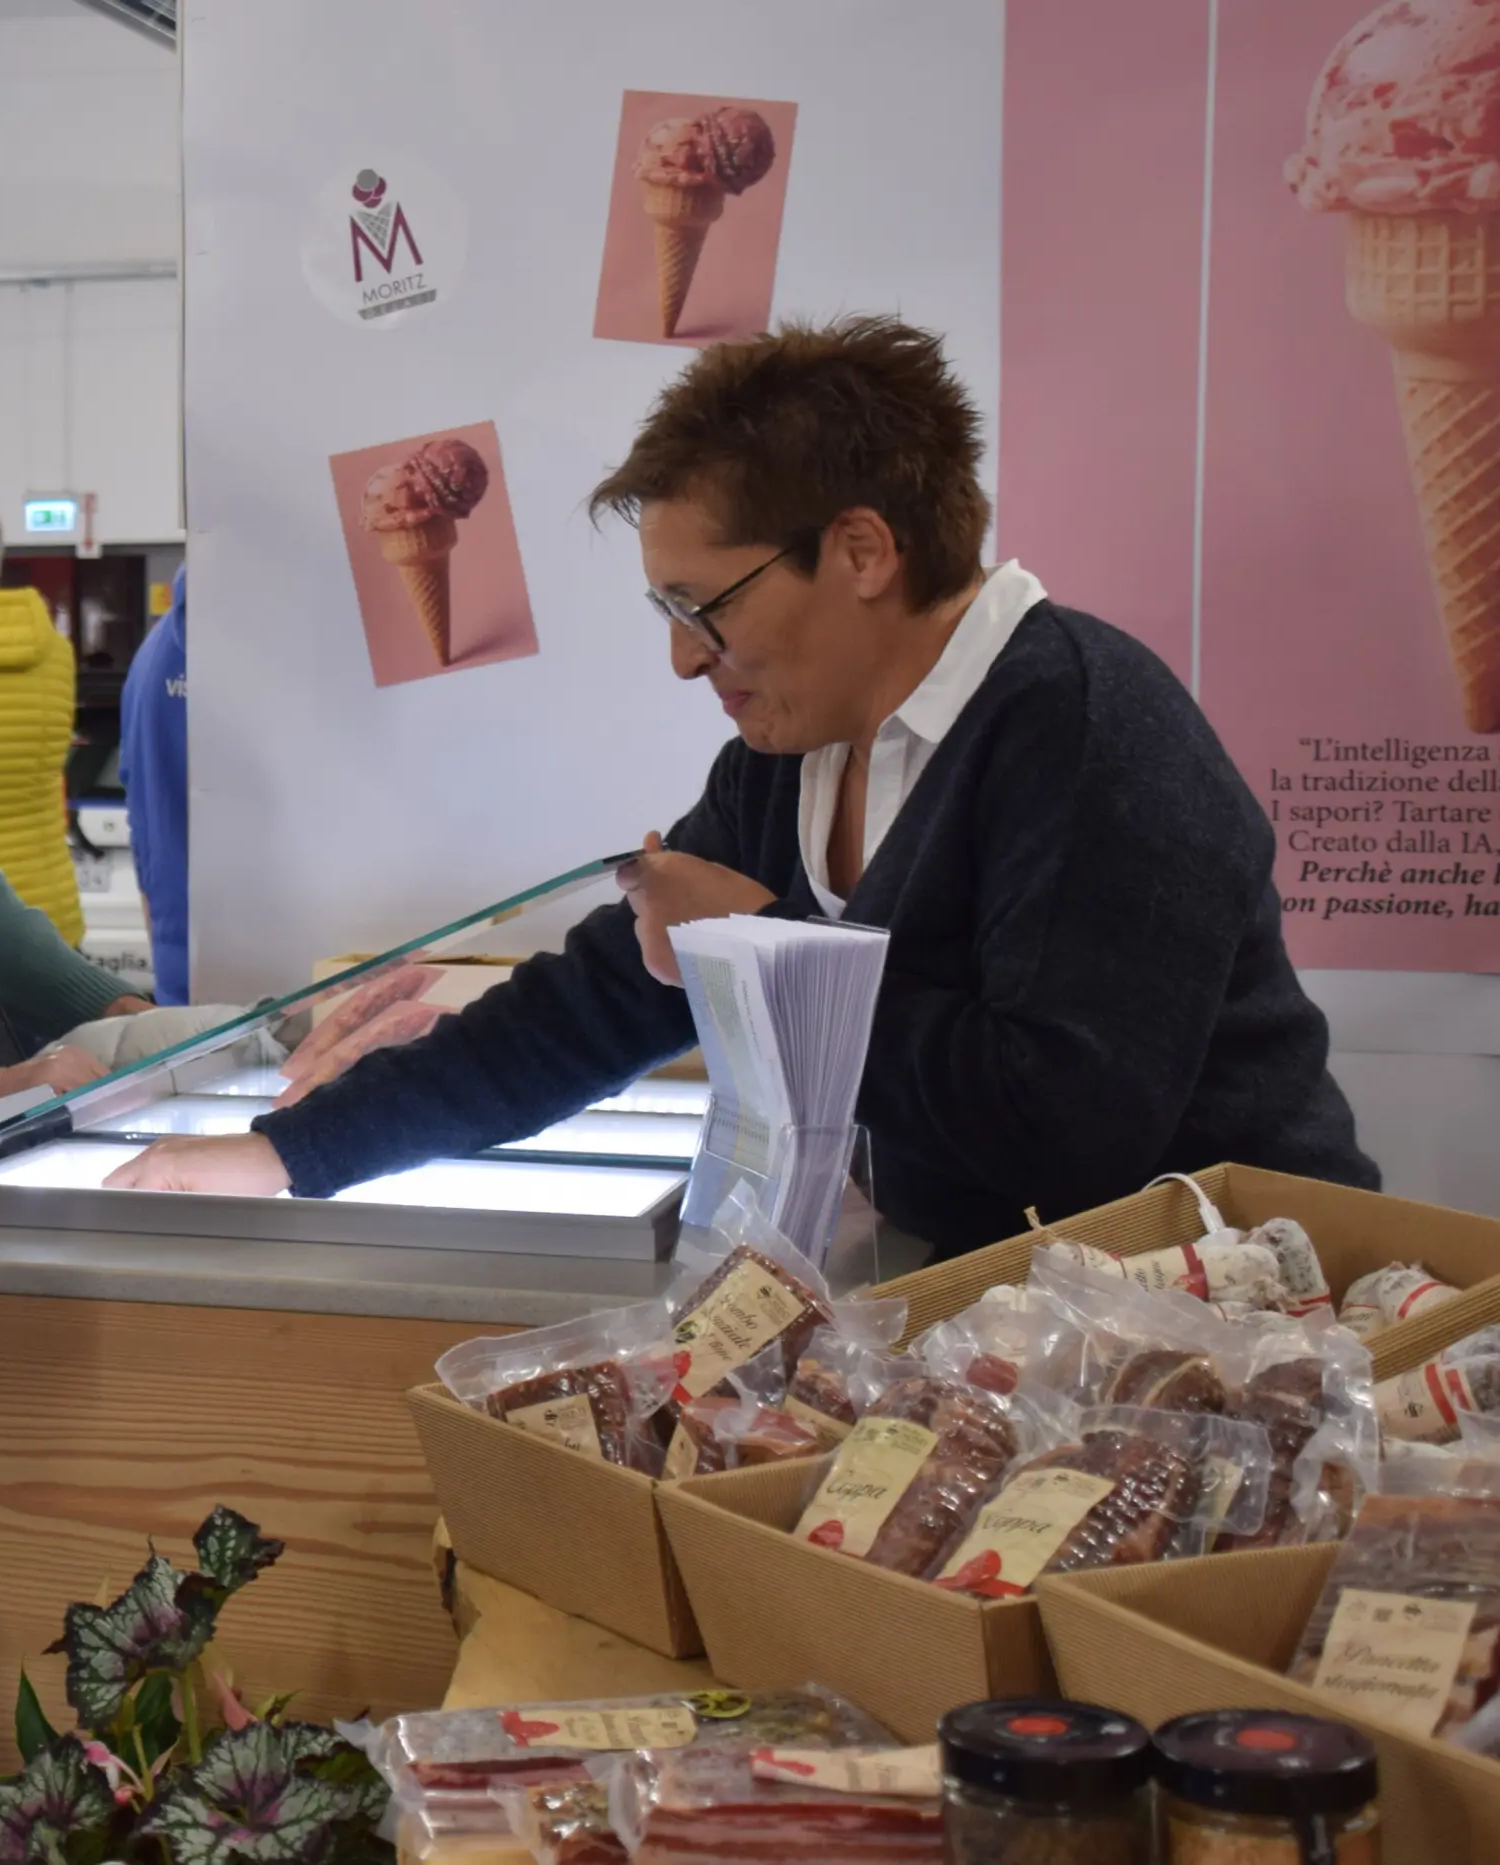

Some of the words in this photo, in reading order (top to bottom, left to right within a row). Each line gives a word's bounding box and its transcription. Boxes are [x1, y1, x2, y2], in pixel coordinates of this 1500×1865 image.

[362, 273, 428, 305] MORITZ
[1299, 738, 1490, 769] “L’intelligenza
[1271, 769, 1292, 792] la
[1302, 769, 1439, 793] tradizione
[1447, 769, 1500, 793] dell
[1272, 800, 1280, 822] I
[1290, 800, 1384, 828] sapori?
[1393, 800, 1491, 823] Tartare
[1288, 829, 1377, 852] Creato
[1386, 830, 1452, 854] dalla
[1298, 860, 1393, 883] Perchè
[1401, 862, 1485, 886] anche
[1281, 896, 1315, 912] on
[1322, 893, 1454, 920] passione,
[826, 1481, 888, 1501] Coppa
[982, 1514, 1053, 1535] Coppa
